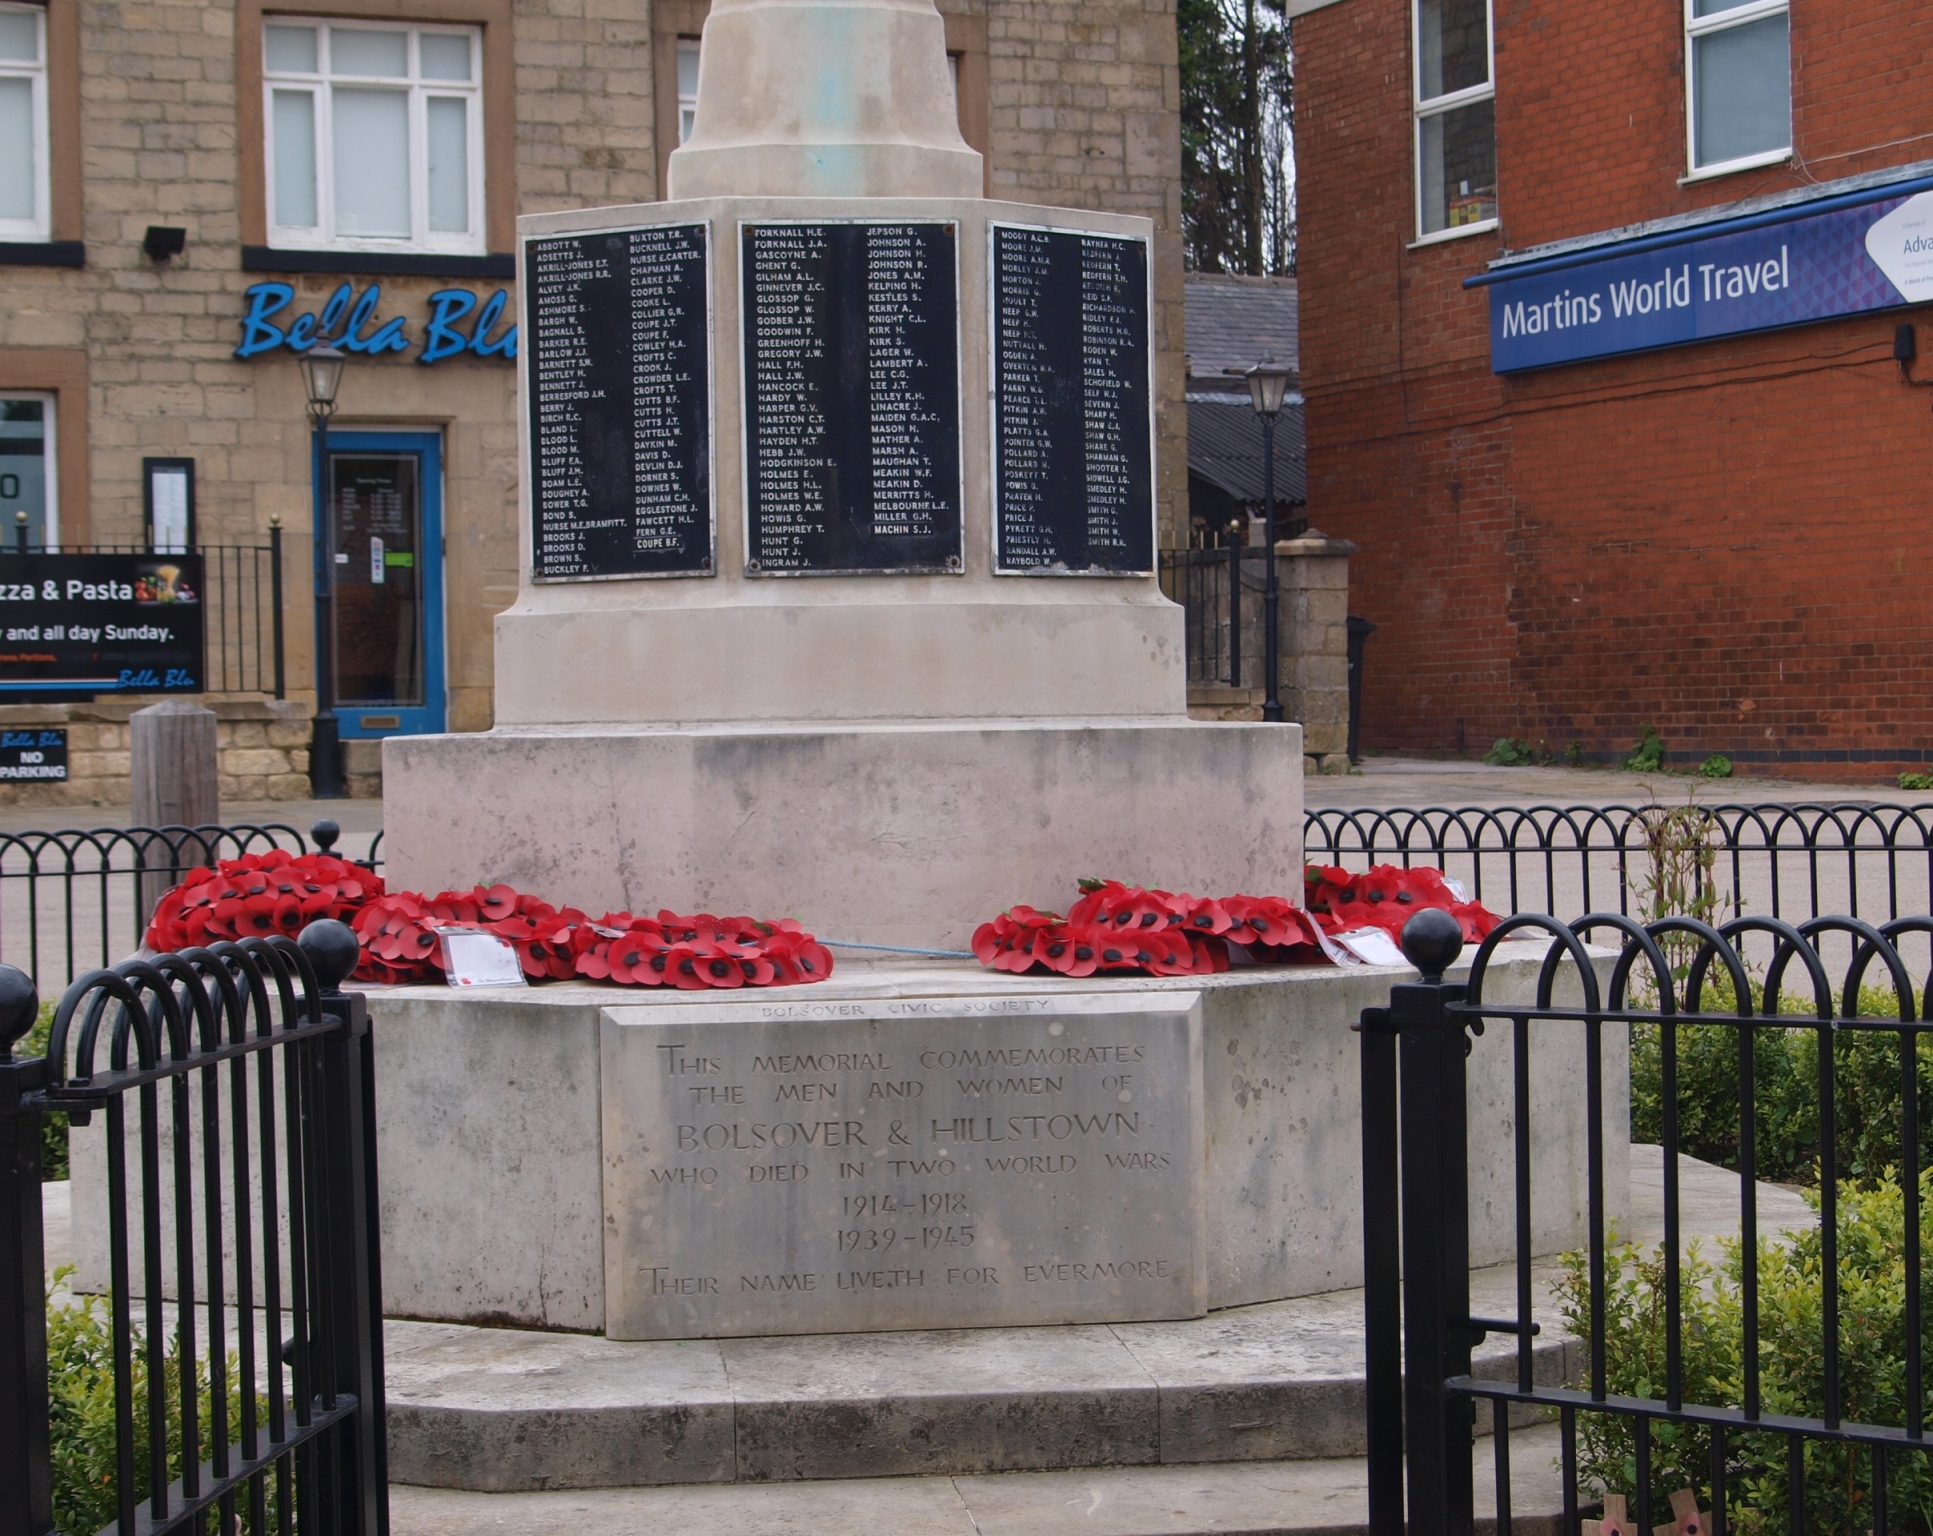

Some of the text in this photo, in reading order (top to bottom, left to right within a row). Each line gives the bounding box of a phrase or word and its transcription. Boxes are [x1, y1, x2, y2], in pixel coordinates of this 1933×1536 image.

[629, 231, 665, 243] BUXTON
[754, 228, 804, 238] FORKNALL
[629, 242, 672, 254] BUCKNELL
[754, 239, 805, 250] FORKNALL
[629, 254, 657, 265] NURSE
[868, 260, 913, 270] JOHNSON
[537, 260, 594, 273] AKRILL-JONES
[537, 270, 594, 284] AKRILL-JONES
[755, 272, 792, 282] GILHAM
[867, 271, 898, 280] JONES
[755, 282, 803, 293] GINNEVER
[1502, 245, 1788, 338] Martins World Travel
[631, 308, 666, 320] COLLIER
[868, 314, 905, 324] KNIGHT
[236, 282, 410, 359] Bella
[632, 340, 666, 352] COWLEY
[757, 349, 802, 359] GREGORY
[538, 358, 577, 370] BARNETT
[632, 373, 672, 385] CROWDER
[539, 390, 590, 402] BERRESFORD
[870, 392, 902, 402] LILLEY
[540, 413, 564, 424] BIRCH
[758, 414, 805, 424] HARSTON
[870, 413, 907, 422] MAIDEN
[1003, 415, 1029, 426] PITKIN
[758, 425, 803, 436] HARTLEY
[541, 467, 566, 477] BLUFF
[634, 461, 665, 472] DEVLIN
[872, 468, 910, 478] MEAKIN
[541, 478, 565, 489] BOAM
[760, 480, 799, 490] HOLMES
[635, 494, 672, 505] DUNHAM
[760, 491, 800, 501] HOLMES
[542, 499, 570, 510] BOWER
[760, 503, 802, 513] HOWARD
[873, 501, 930, 511] MELBOURNE
[635, 515, 675, 526] FAWCETT
[874, 512, 908, 522] MILLER
[542, 521, 569, 532] NURSE
[874, 524, 909, 535] MACHIN
[42, 580, 60, 601] &
[67, 580, 133, 601] Pasta
[7, 625, 174, 643] and all day Sunday.
[118, 669, 160, 688] Bella
[20, 751, 44, 763] NO
[0, 766, 66, 778] PARKING
[762, 999, 1049, 1018] BOLSOVER CIVIC SOCIETY
[658, 1044, 1144, 1078] THIS MEMORIAL COMMEMORATES
[690, 1074, 1132, 1105] THE MEN AND WOMEN OF
[678, 1112, 1140, 1152] BOLSOVER & HILLSTOWN
[652, 1152, 1171, 1186] WHO DIED IN TWO WORLD WARS
[640, 1260, 1169, 1298] THEIR NAME LIVETH FOR EVERMORE
